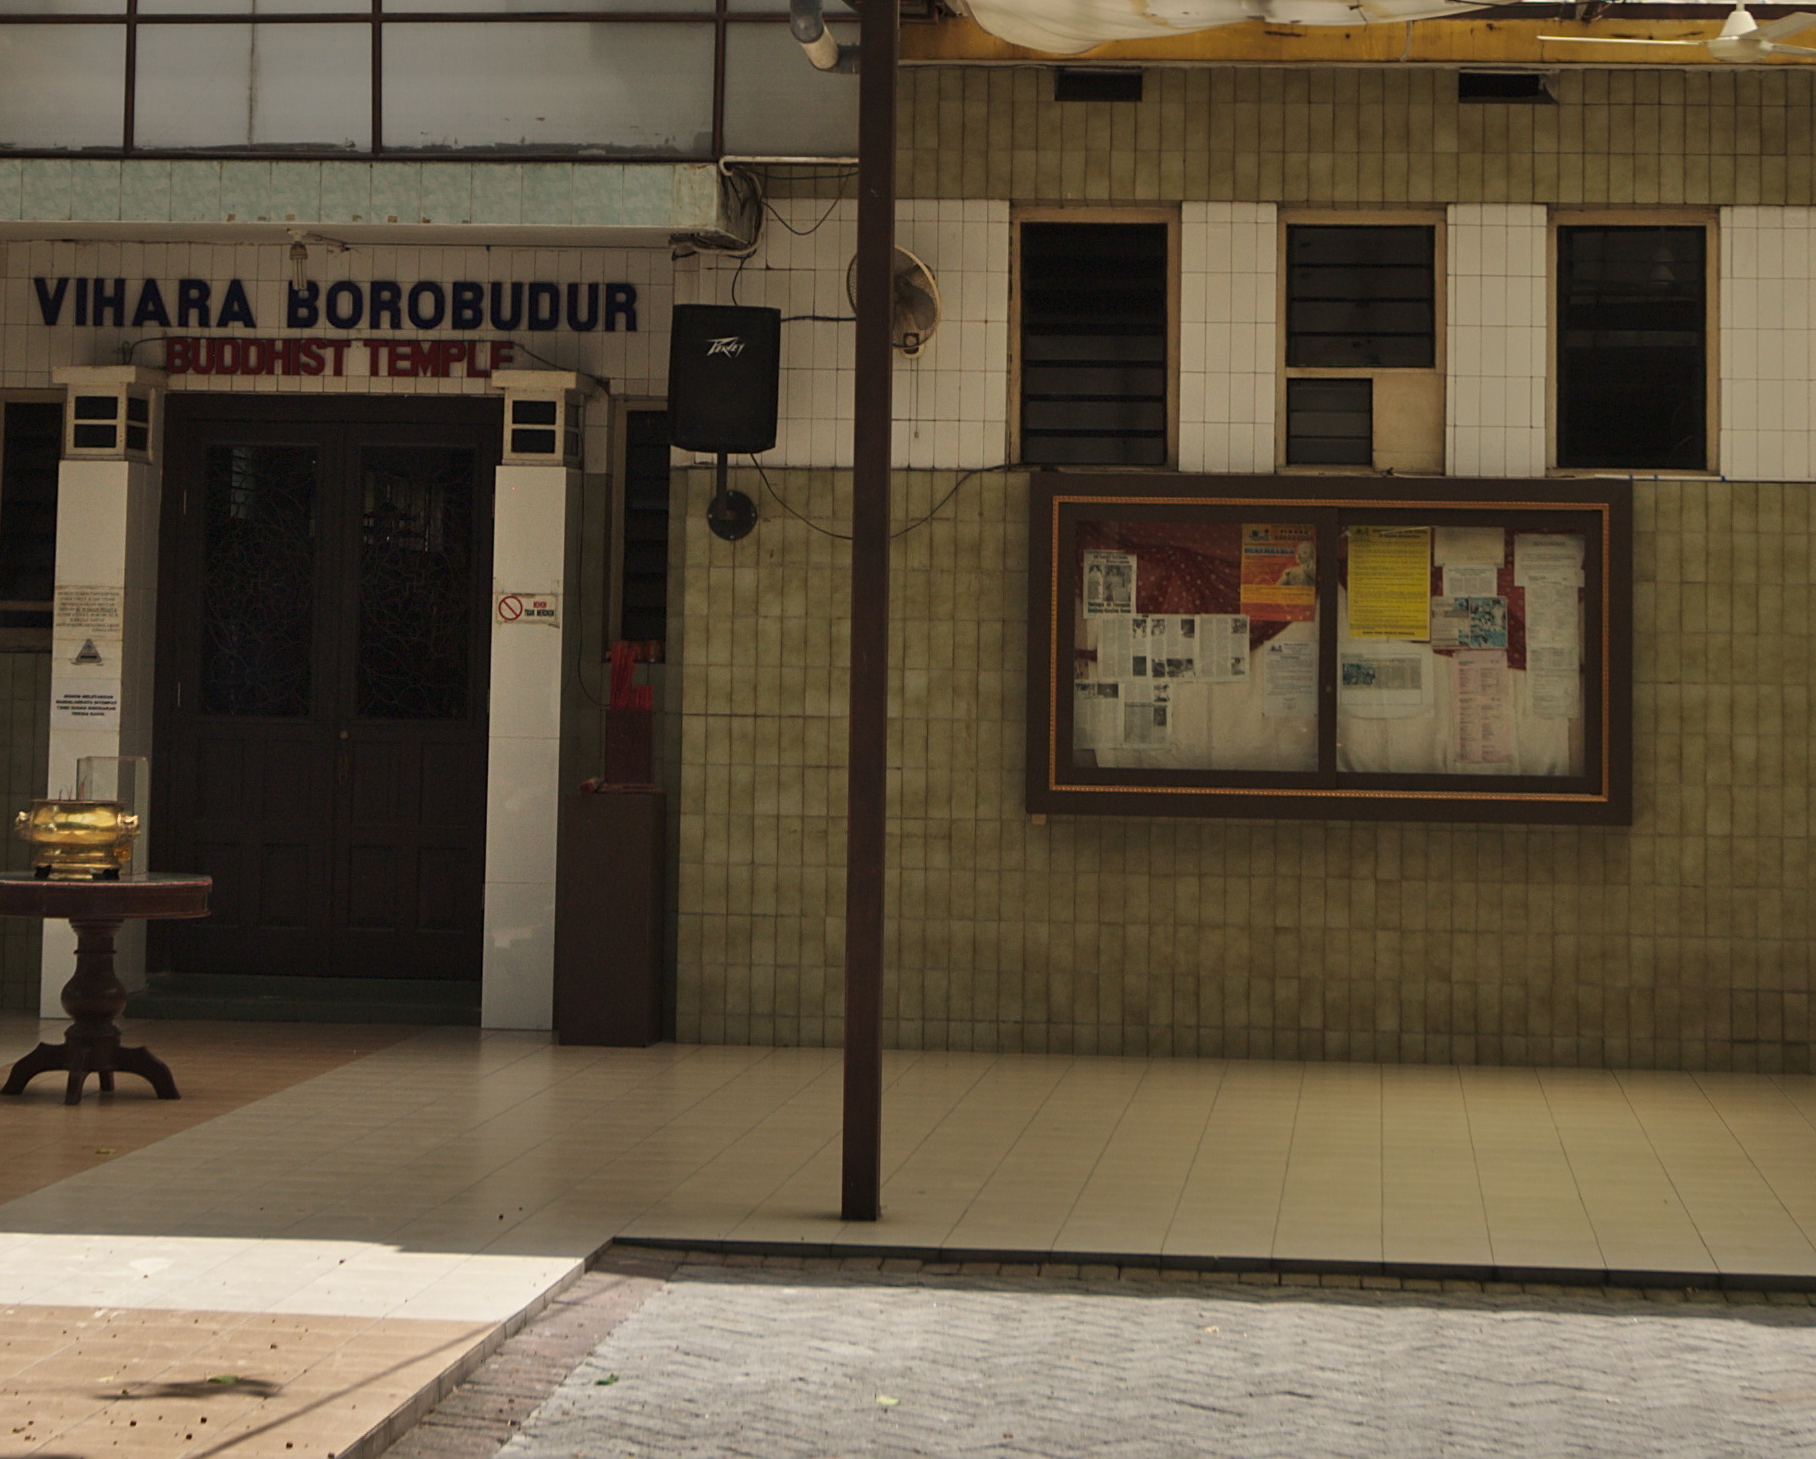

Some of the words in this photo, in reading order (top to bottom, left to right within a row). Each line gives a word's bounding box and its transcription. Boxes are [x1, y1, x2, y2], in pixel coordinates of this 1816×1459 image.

[33, 278, 257, 328] VIHARA
[287, 279, 637, 332] BOROBUDUR
[165, 337, 352, 377] BUDDHIST
[364, 339, 514, 377] TEMPLE
